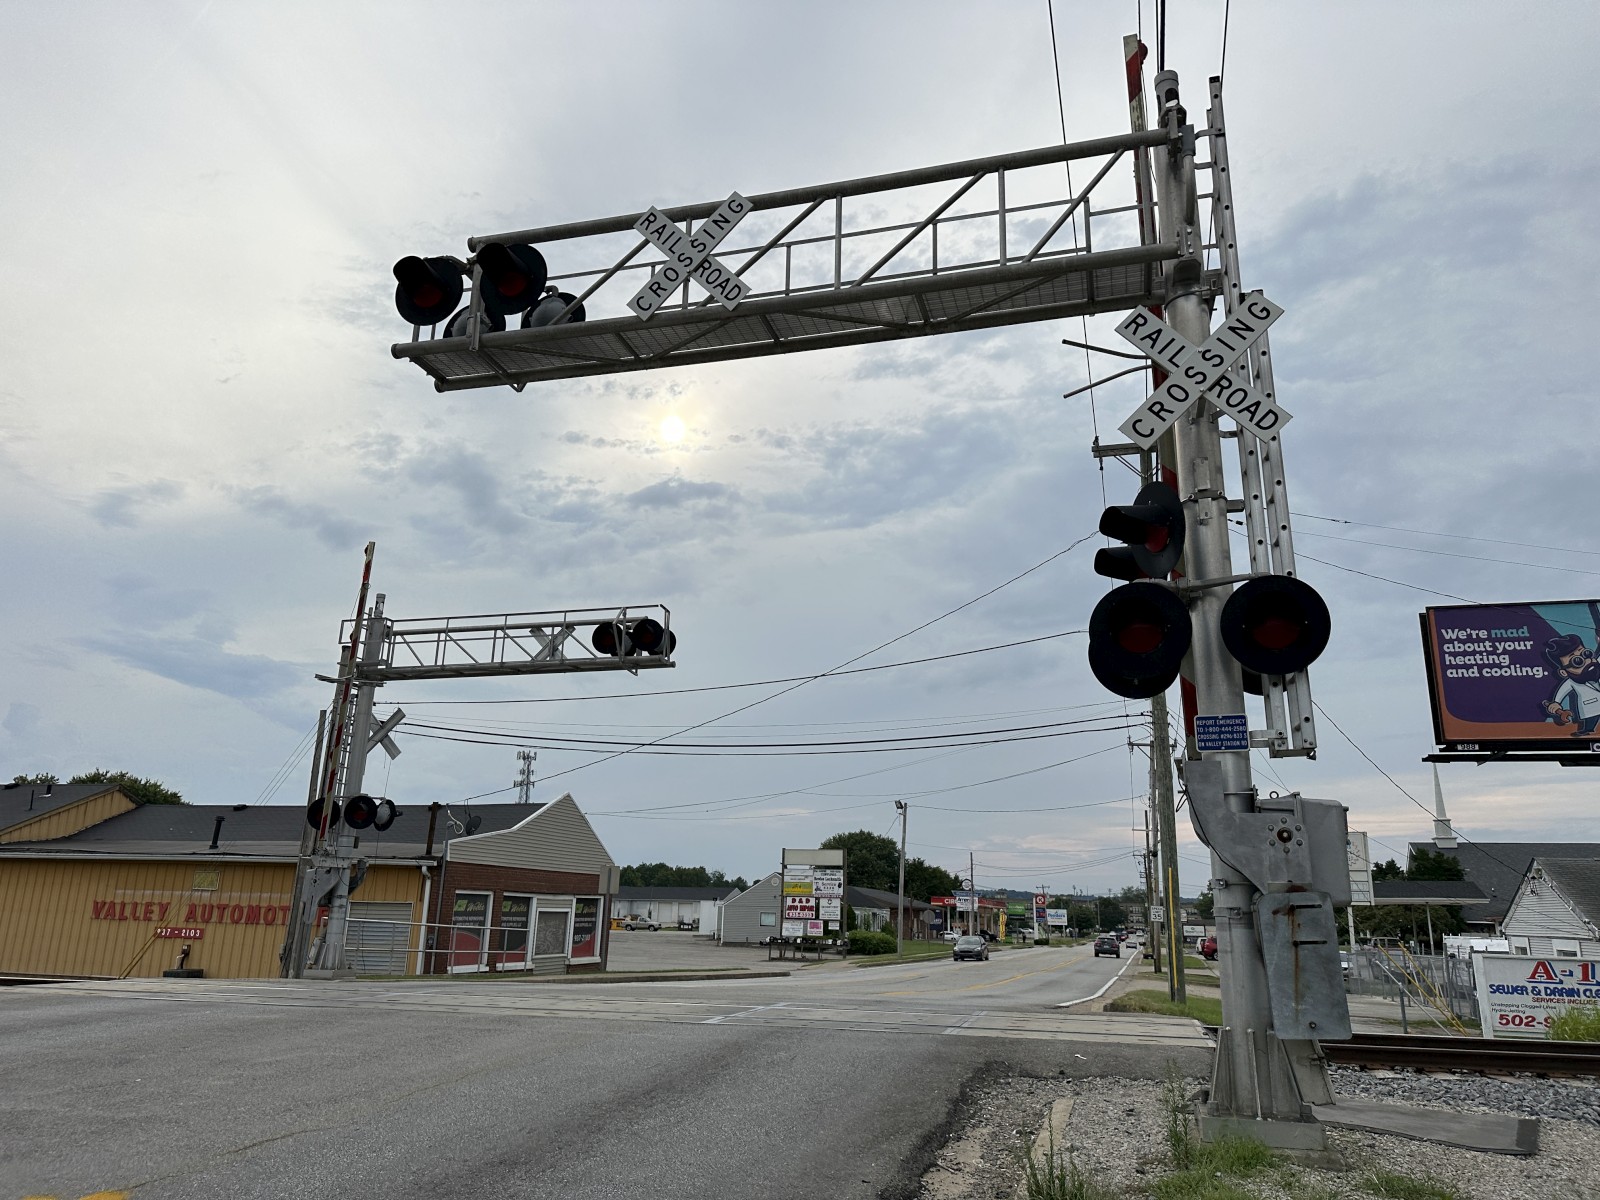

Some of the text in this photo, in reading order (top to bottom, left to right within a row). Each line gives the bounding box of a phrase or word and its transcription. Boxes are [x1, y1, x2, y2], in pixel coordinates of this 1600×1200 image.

[636, 199, 744, 312] CROSSING
[640, 212, 742, 302] RAIL ROAD
[1124, 312, 1279, 431] RAIL ROAD
[1131, 302, 1271, 439] CROSSING
[1441, 626, 1530, 640] We're mad
[1443, 640, 1534, 654] about your
[1445, 653, 1510, 666] heating
[1446, 664, 1549, 679] and cooling.
[92, 900, 171, 921] VALLEY
[786, 904, 799, 912] AUTO
[799, 904, 815, 912] REPAIR
[1526, 960, 1600, 987] A-1
[1488, 984, 1529, 996] SEWER
[1530, 986, 1542, 997] &
[1544, 986, 1581, 998] DRAIN
[1532, 996, 1598, 1006] SERVICES INCLUDE
